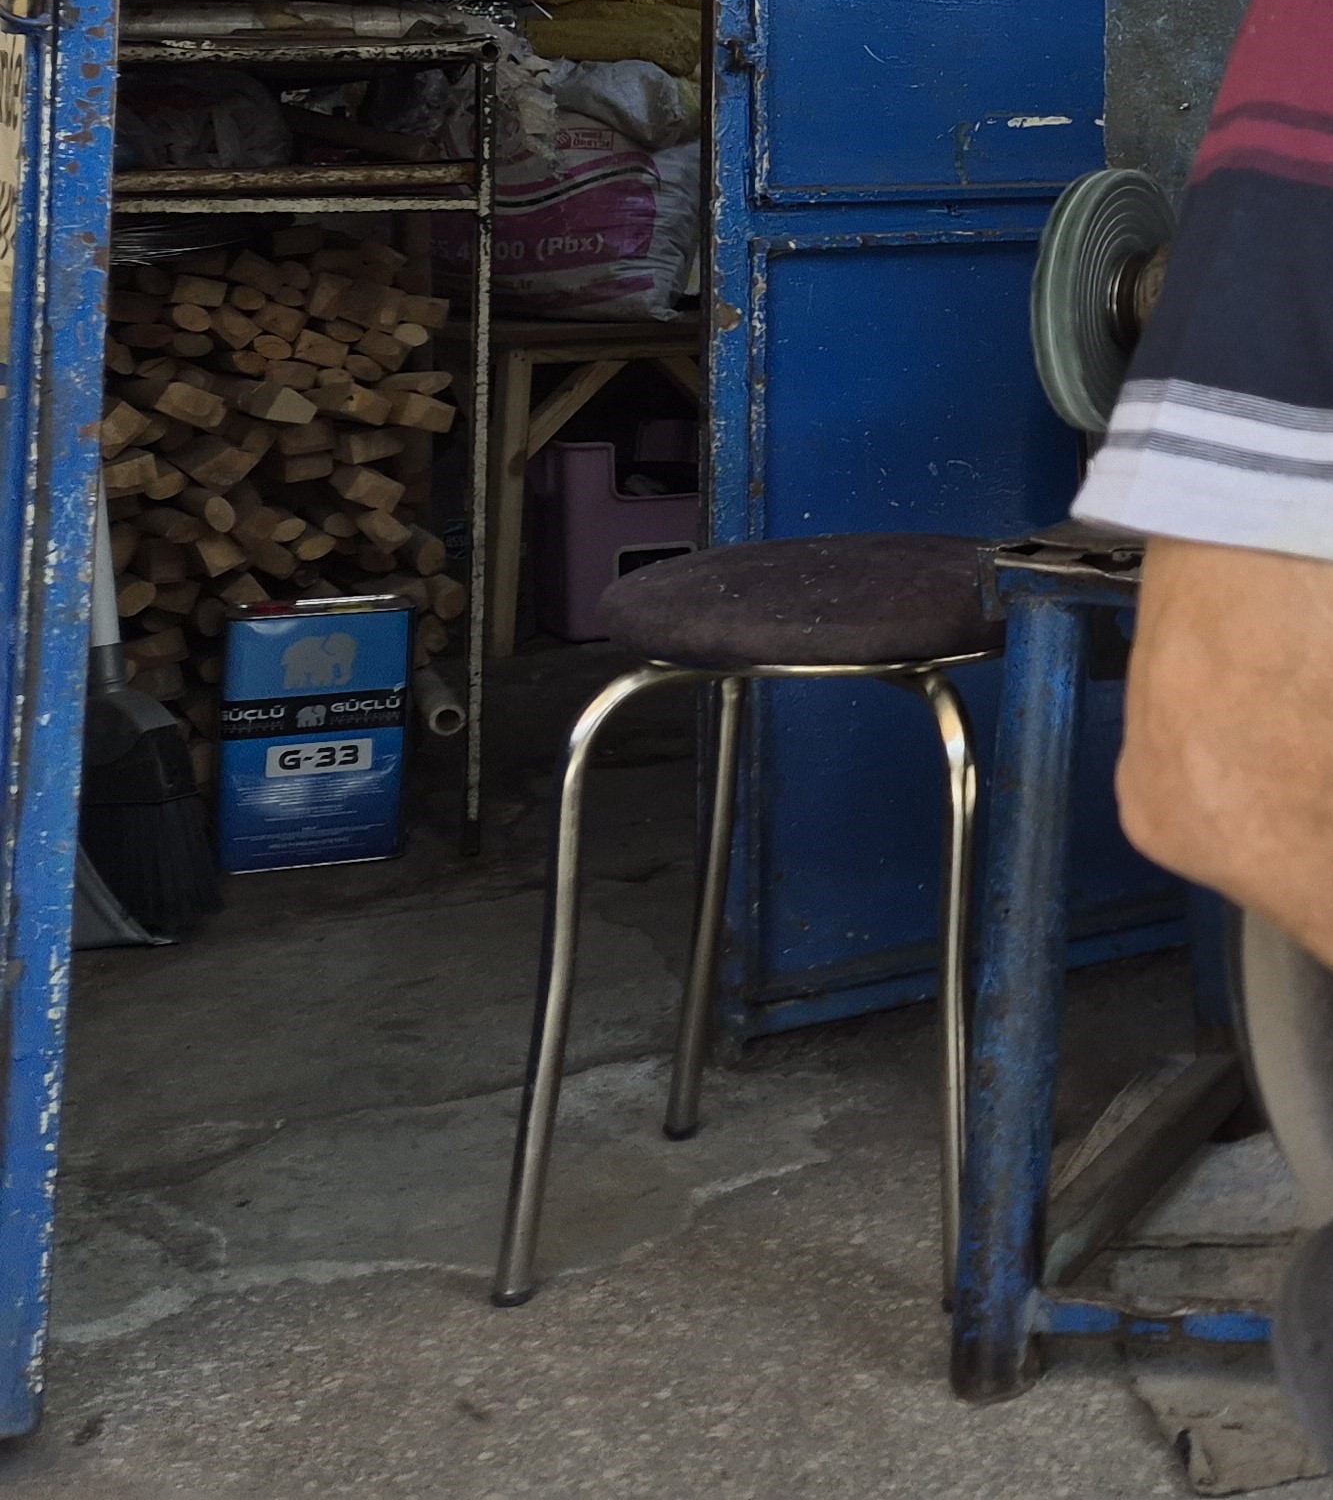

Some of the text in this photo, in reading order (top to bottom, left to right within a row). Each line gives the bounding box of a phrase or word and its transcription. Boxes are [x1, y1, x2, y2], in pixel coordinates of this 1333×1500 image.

[536, 232, 605, 261] (Pbx)
[330, 695, 402, 716] GÜÇLÜ
[278, 745, 360, 771] G-33
